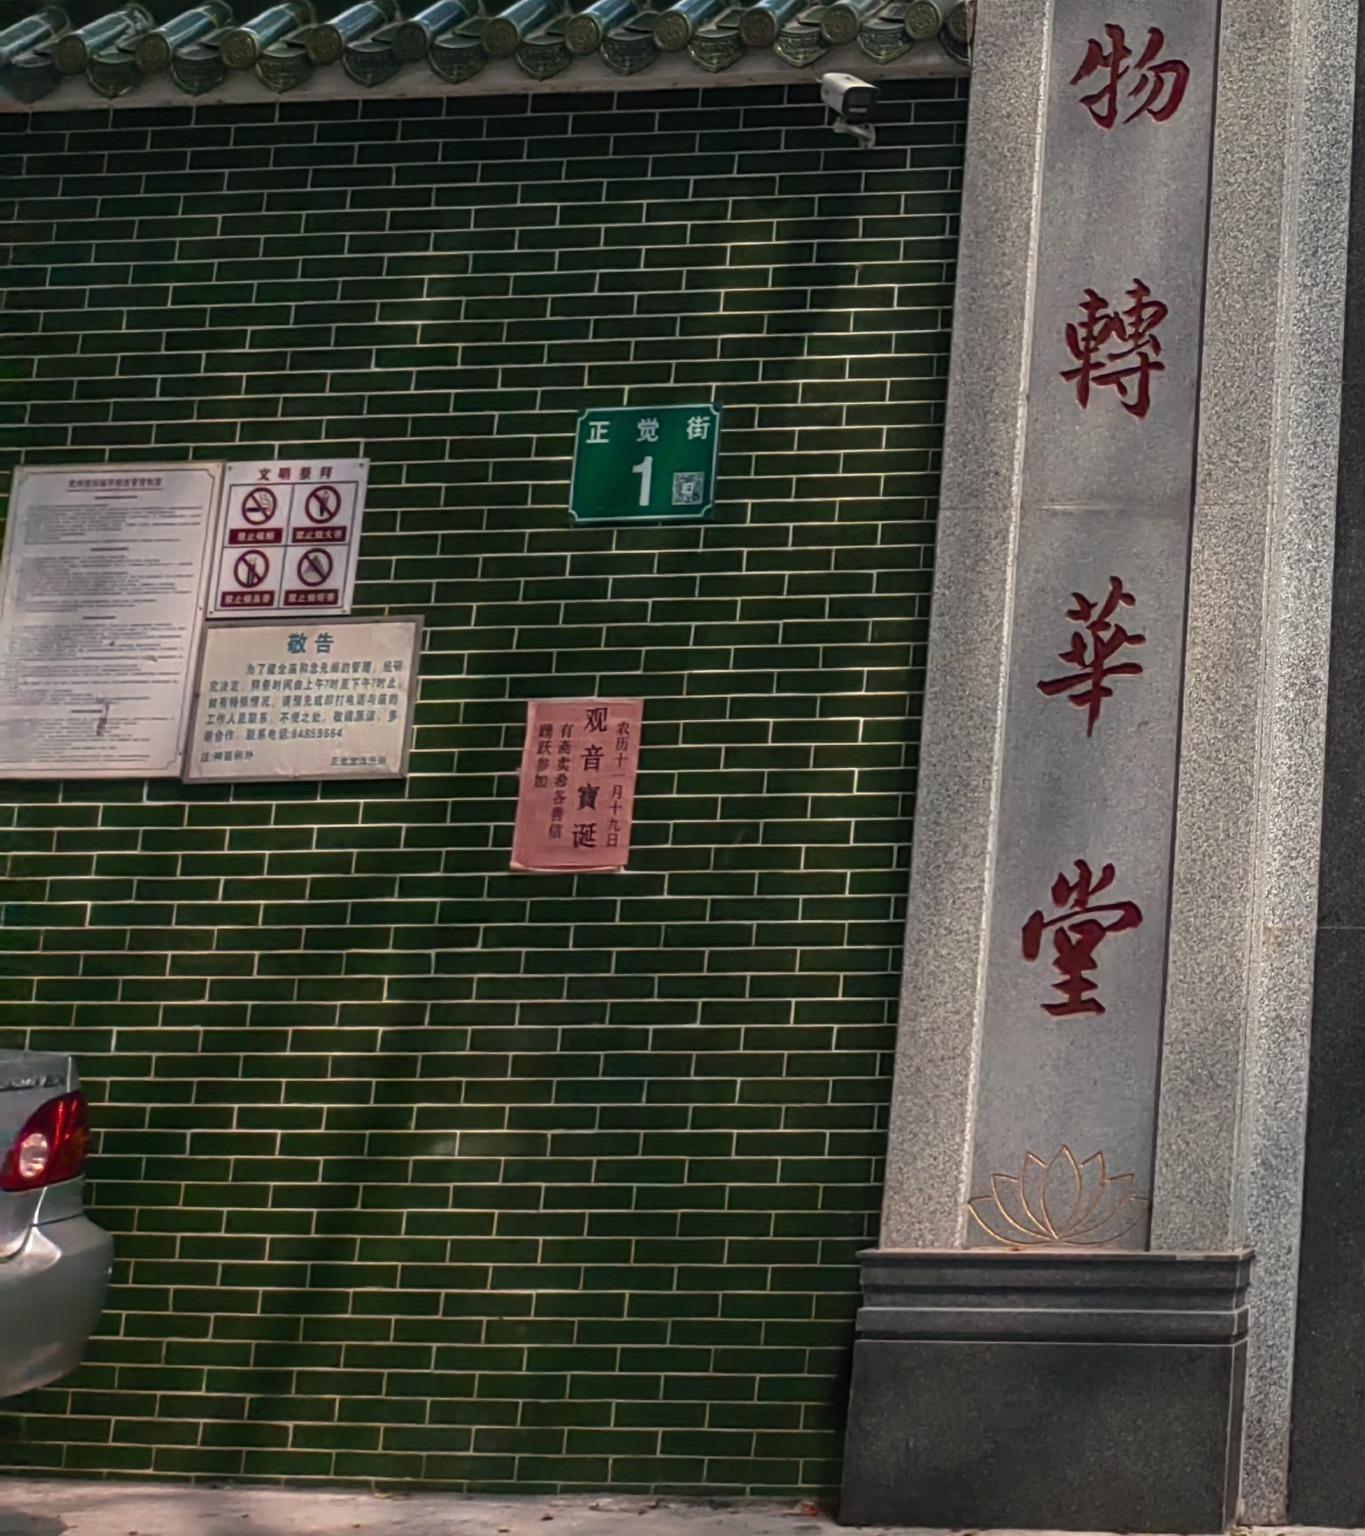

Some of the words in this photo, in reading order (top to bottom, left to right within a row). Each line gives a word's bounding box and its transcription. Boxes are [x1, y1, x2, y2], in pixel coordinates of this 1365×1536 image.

[585, 415, 711, 445] 正觉街
[631, 455, 653, 508] 1
[1016, 21, 1190, 1020] 物轉華堂
[287, 632, 335, 655] 敬告
[605, 720, 631, 848] 农历十一月十九日
